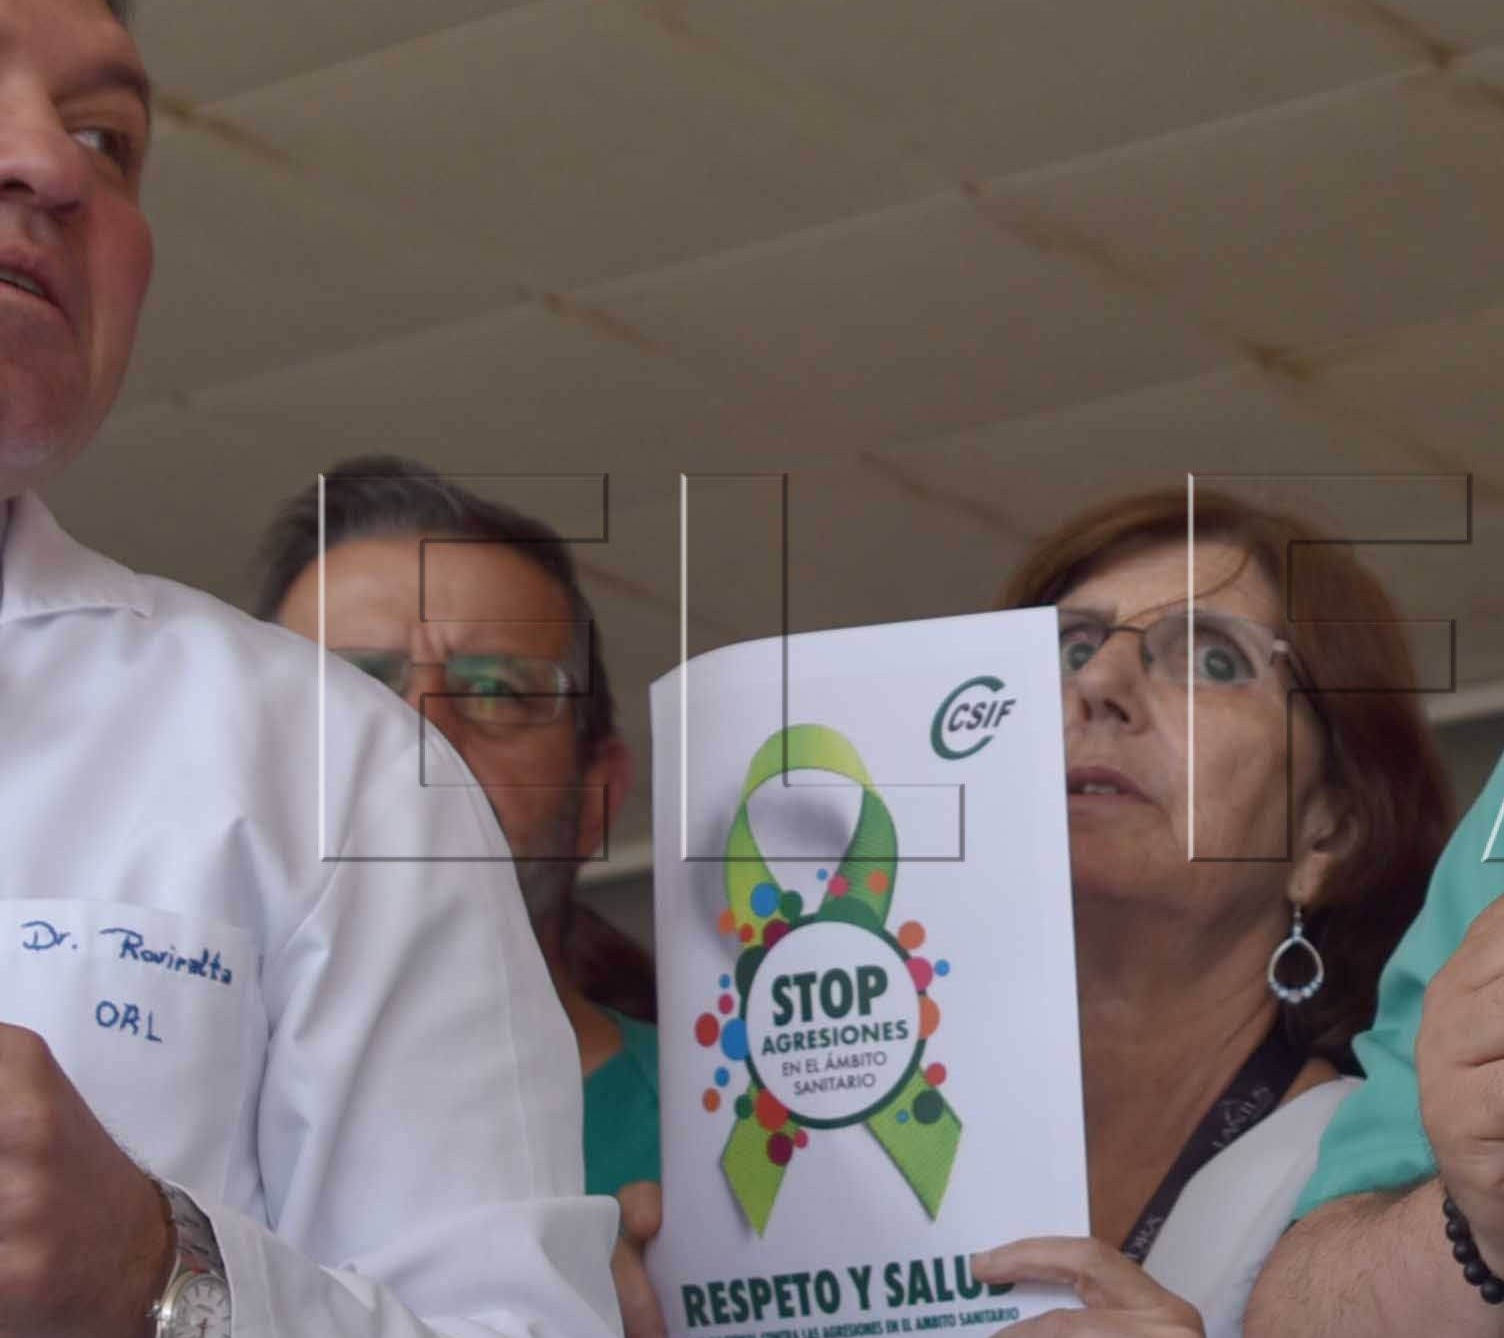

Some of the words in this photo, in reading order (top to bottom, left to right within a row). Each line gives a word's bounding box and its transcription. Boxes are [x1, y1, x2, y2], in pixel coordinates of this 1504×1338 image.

[947, 698, 1017, 732] CSIF
[21, 921, 78, 950] Dr.
[771, 965, 888, 1027] STOP
[95, 1000, 163, 1043] ORL
[761, 1019, 909, 1057] AGRESIONES
[782, 1061, 801, 1077] EN
[805, 1058, 820, 1073] EL
[825, 1050, 887, 1071] ÁMBITO
[794, 1073, 876, 1096] SANITARIO
[681, 1268, 841, 1328] RESPETO
[847, 1264, 873, 1310] Y
[883, 1253, 1015, 1309] SALU
